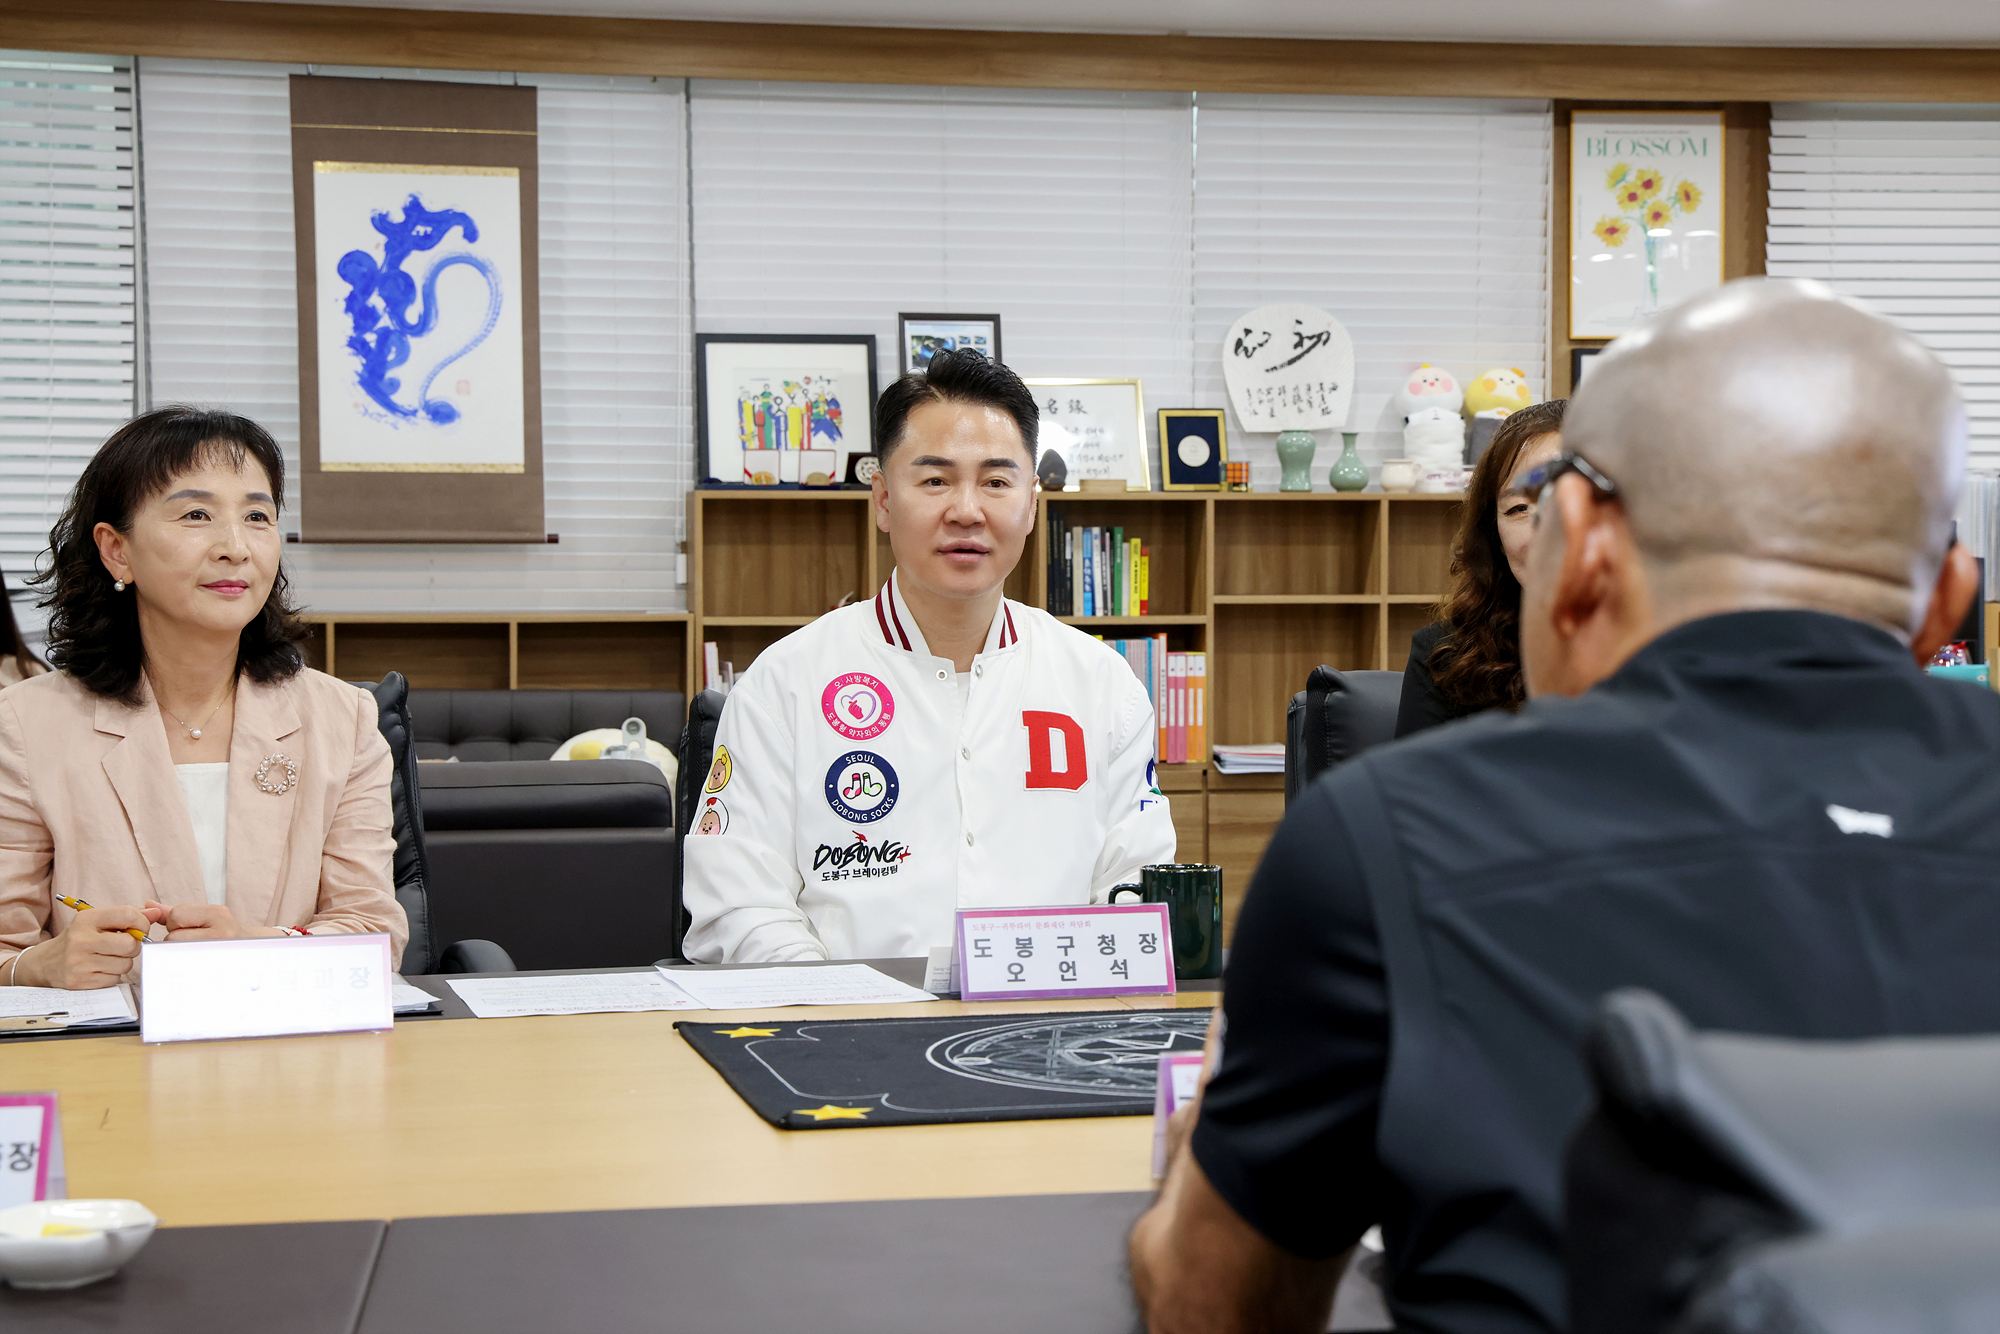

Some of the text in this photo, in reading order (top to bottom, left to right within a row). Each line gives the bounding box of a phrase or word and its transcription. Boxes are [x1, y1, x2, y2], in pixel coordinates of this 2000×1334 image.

[1587, 136, 1707, 157] BLOSSOM
[845, 754, 875, 765] SEOUL
[1023, 711, 1089, 790] D
[831, 797, 894, 821] DOBONG SOCKS
[812, 840, 904, 871] DOBONG
[821, 865, 898, 882] 도봉구 브레이킹팀
[1035, 920, 1066, 930] 문화재단
[0, 1142, 40, 1171] 장
